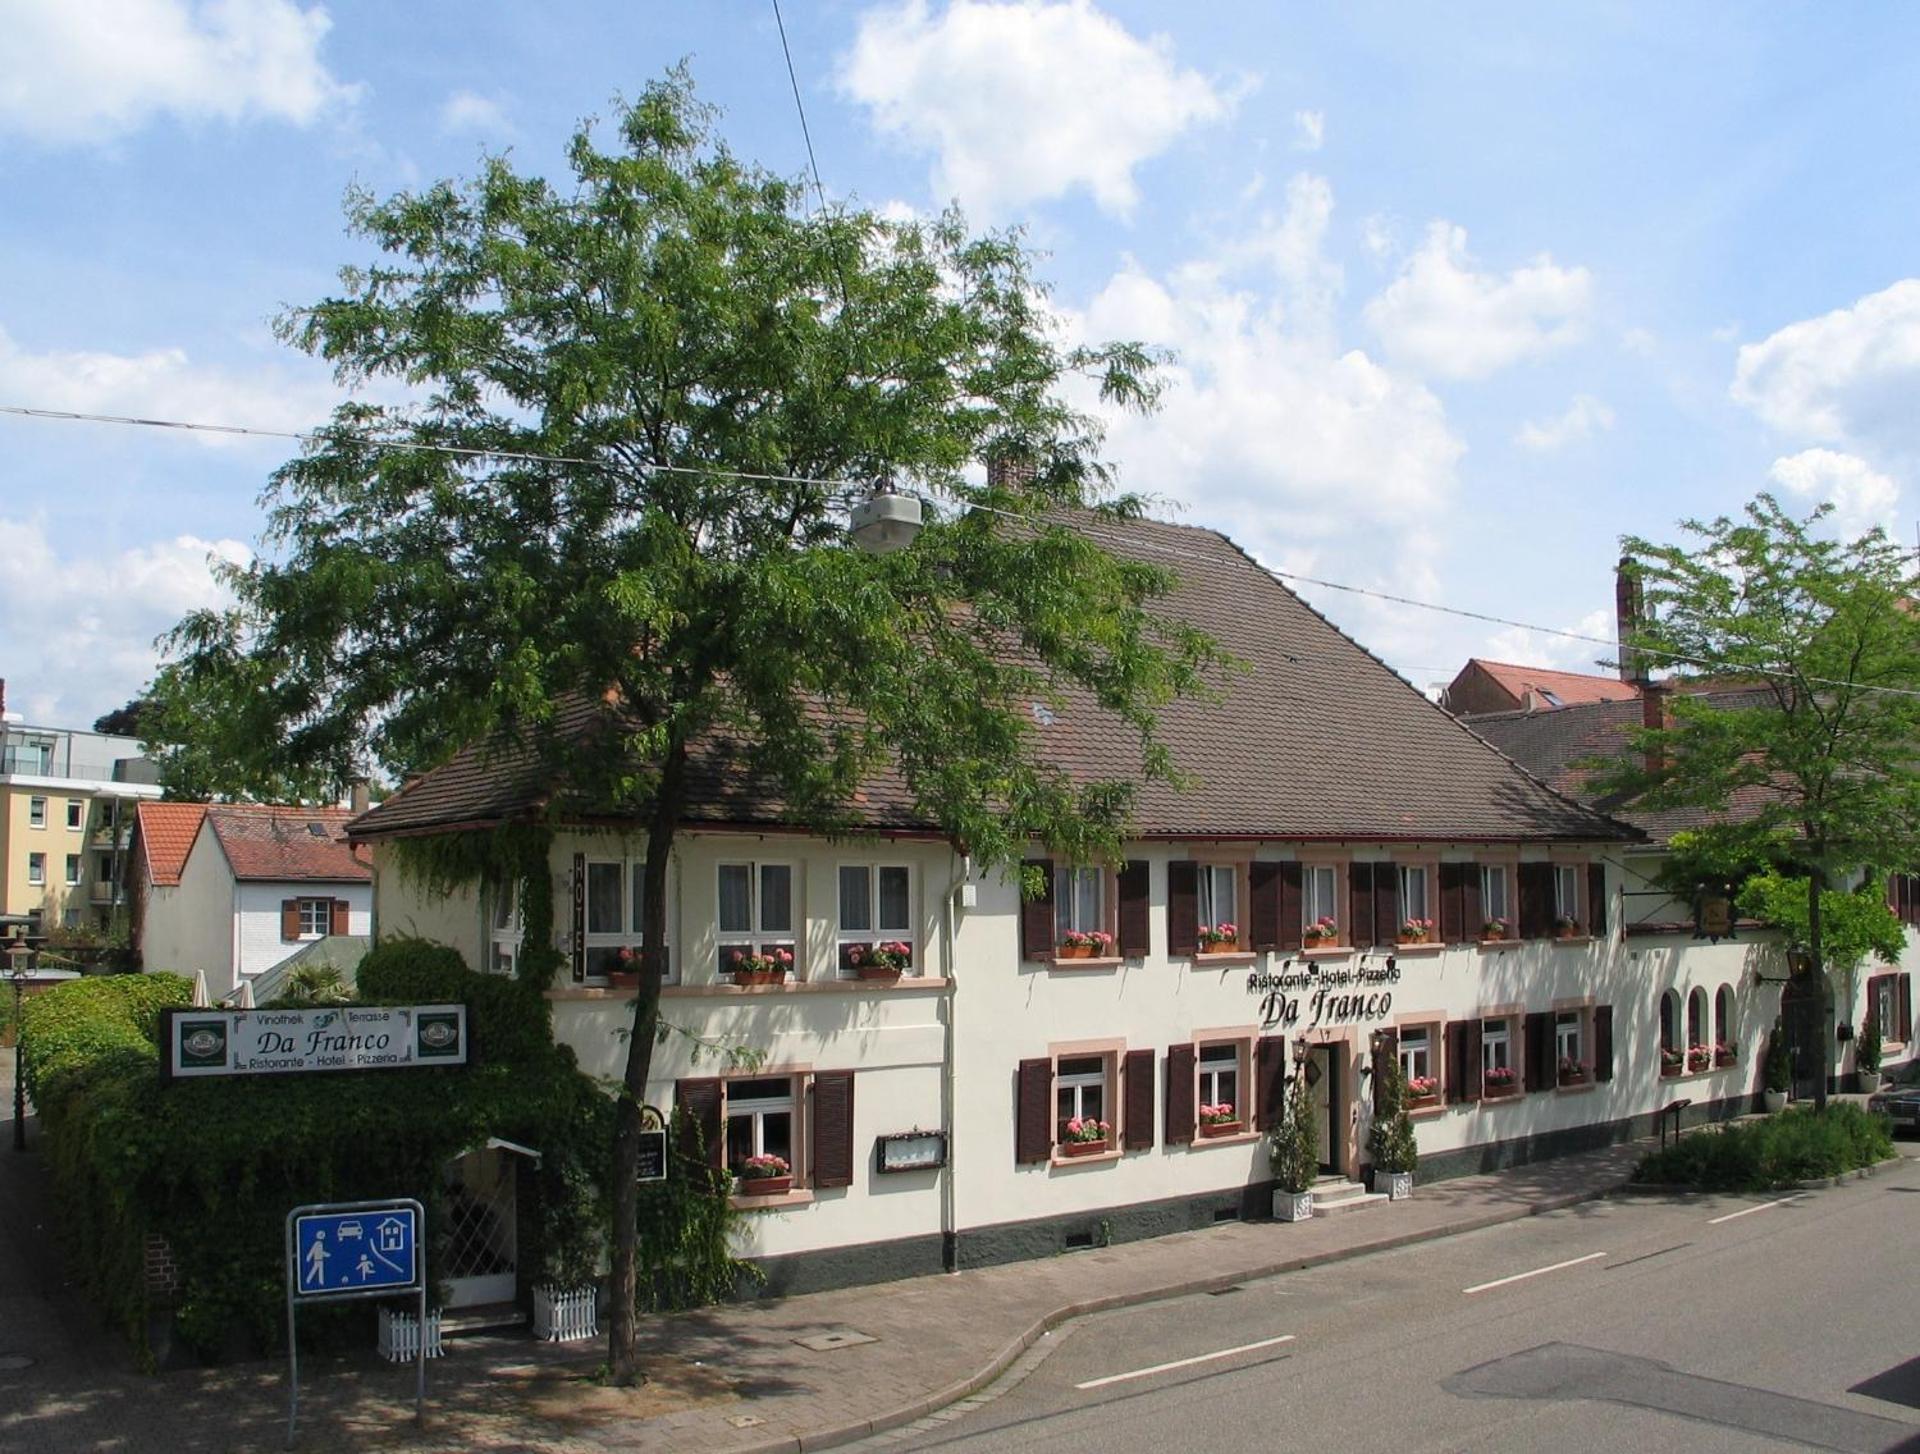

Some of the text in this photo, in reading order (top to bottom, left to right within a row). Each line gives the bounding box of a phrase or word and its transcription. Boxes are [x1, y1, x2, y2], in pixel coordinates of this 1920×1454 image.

[575, 857, 583, 976] HOTEL
[257, 1012, 390, 1025] Vinothek Terrasse
[1261, 990, 1392, 1026] Da Franco
[257, 1030, 390, 1056] Da Franco
[249, 1058, 304, 1069] Ristorante
[317, 1055, 346, 1066] Hotel
[357, 1054, 398, 1064] Pizzeria
